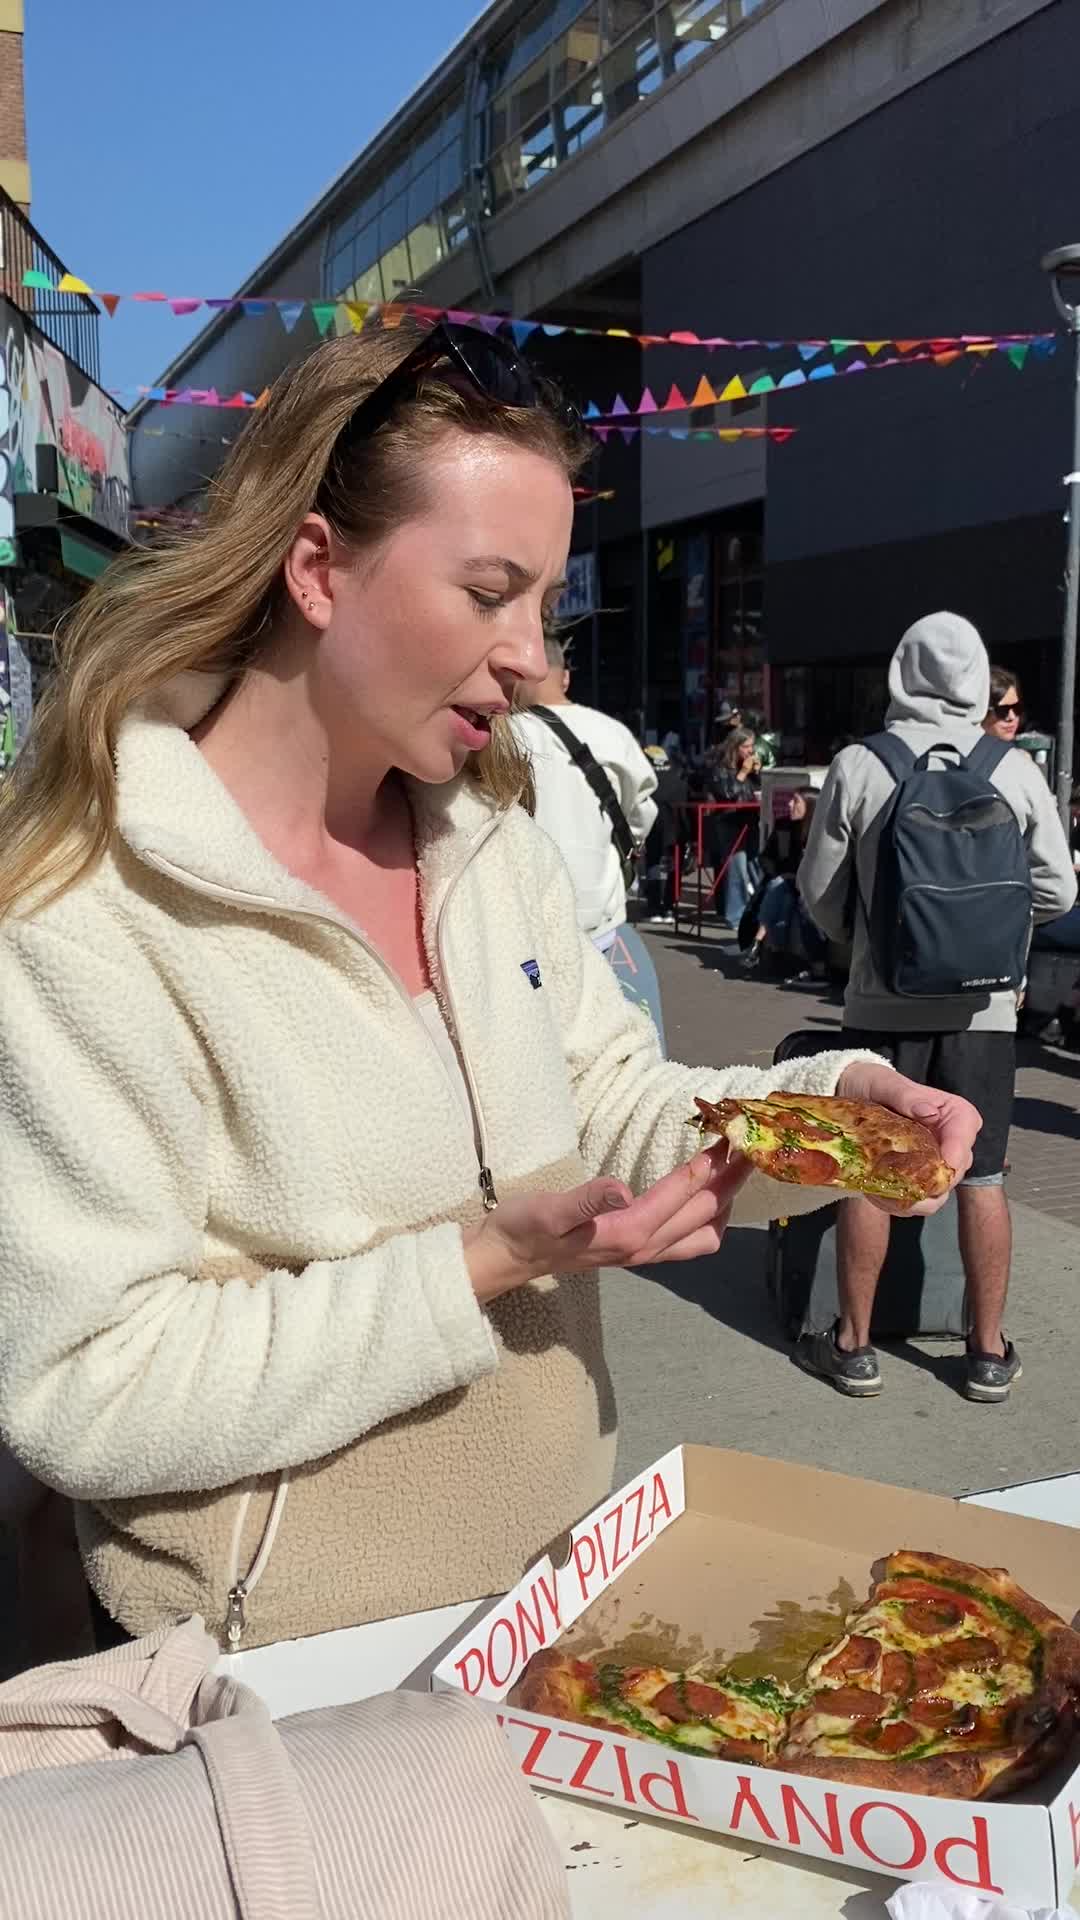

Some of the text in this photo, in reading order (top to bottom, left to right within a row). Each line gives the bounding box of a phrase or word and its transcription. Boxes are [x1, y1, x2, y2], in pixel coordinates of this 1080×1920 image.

[961, 978, 997, 987] adidas
[454, 1472, 672, 1696] PONY PIZZA
[496, 1714, 700, 1821] PIZZ
[729, 1775, 1004, 1896] PONY
